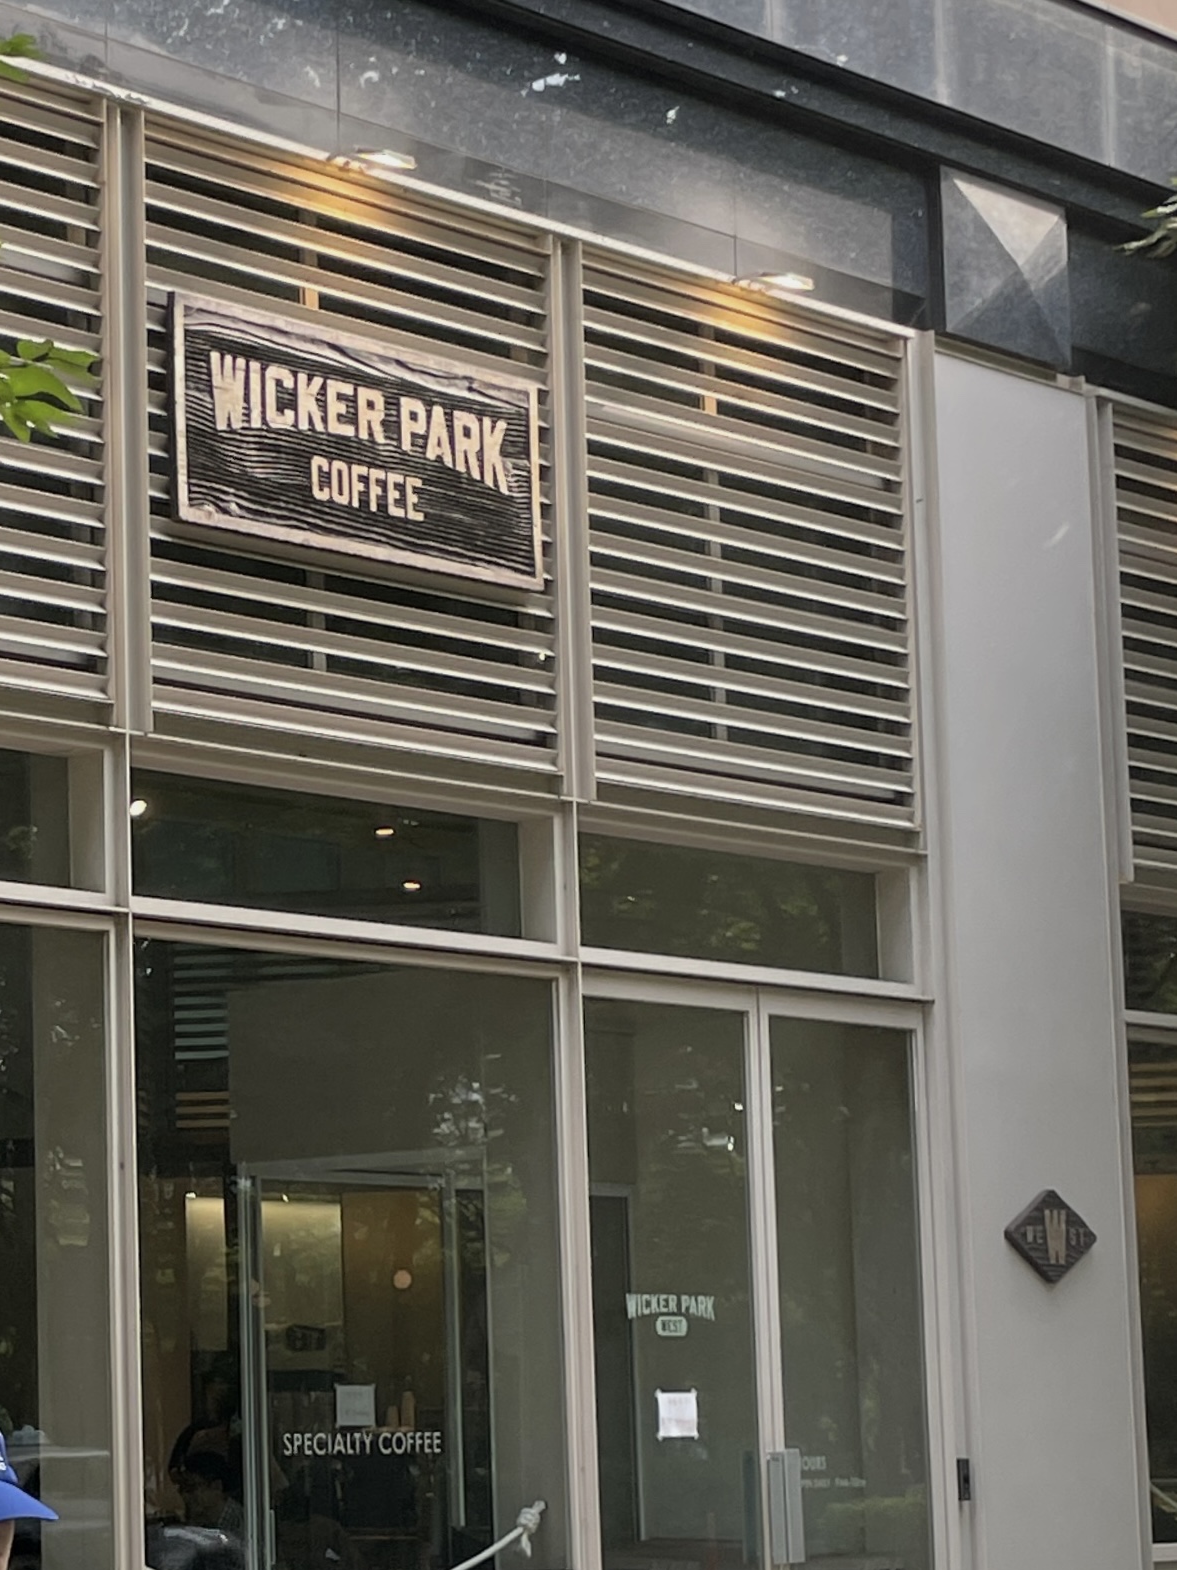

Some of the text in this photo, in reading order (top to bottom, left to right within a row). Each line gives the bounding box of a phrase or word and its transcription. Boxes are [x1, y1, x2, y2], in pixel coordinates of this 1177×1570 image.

[209, 351, 510, 496] WICKER PARK
[310, 455, 425, 522] COFFEE
[625, 1293, 716, 1321] WICKER PARK
[283, 1431, 442, 1456] SPECIALTY COFFEE
